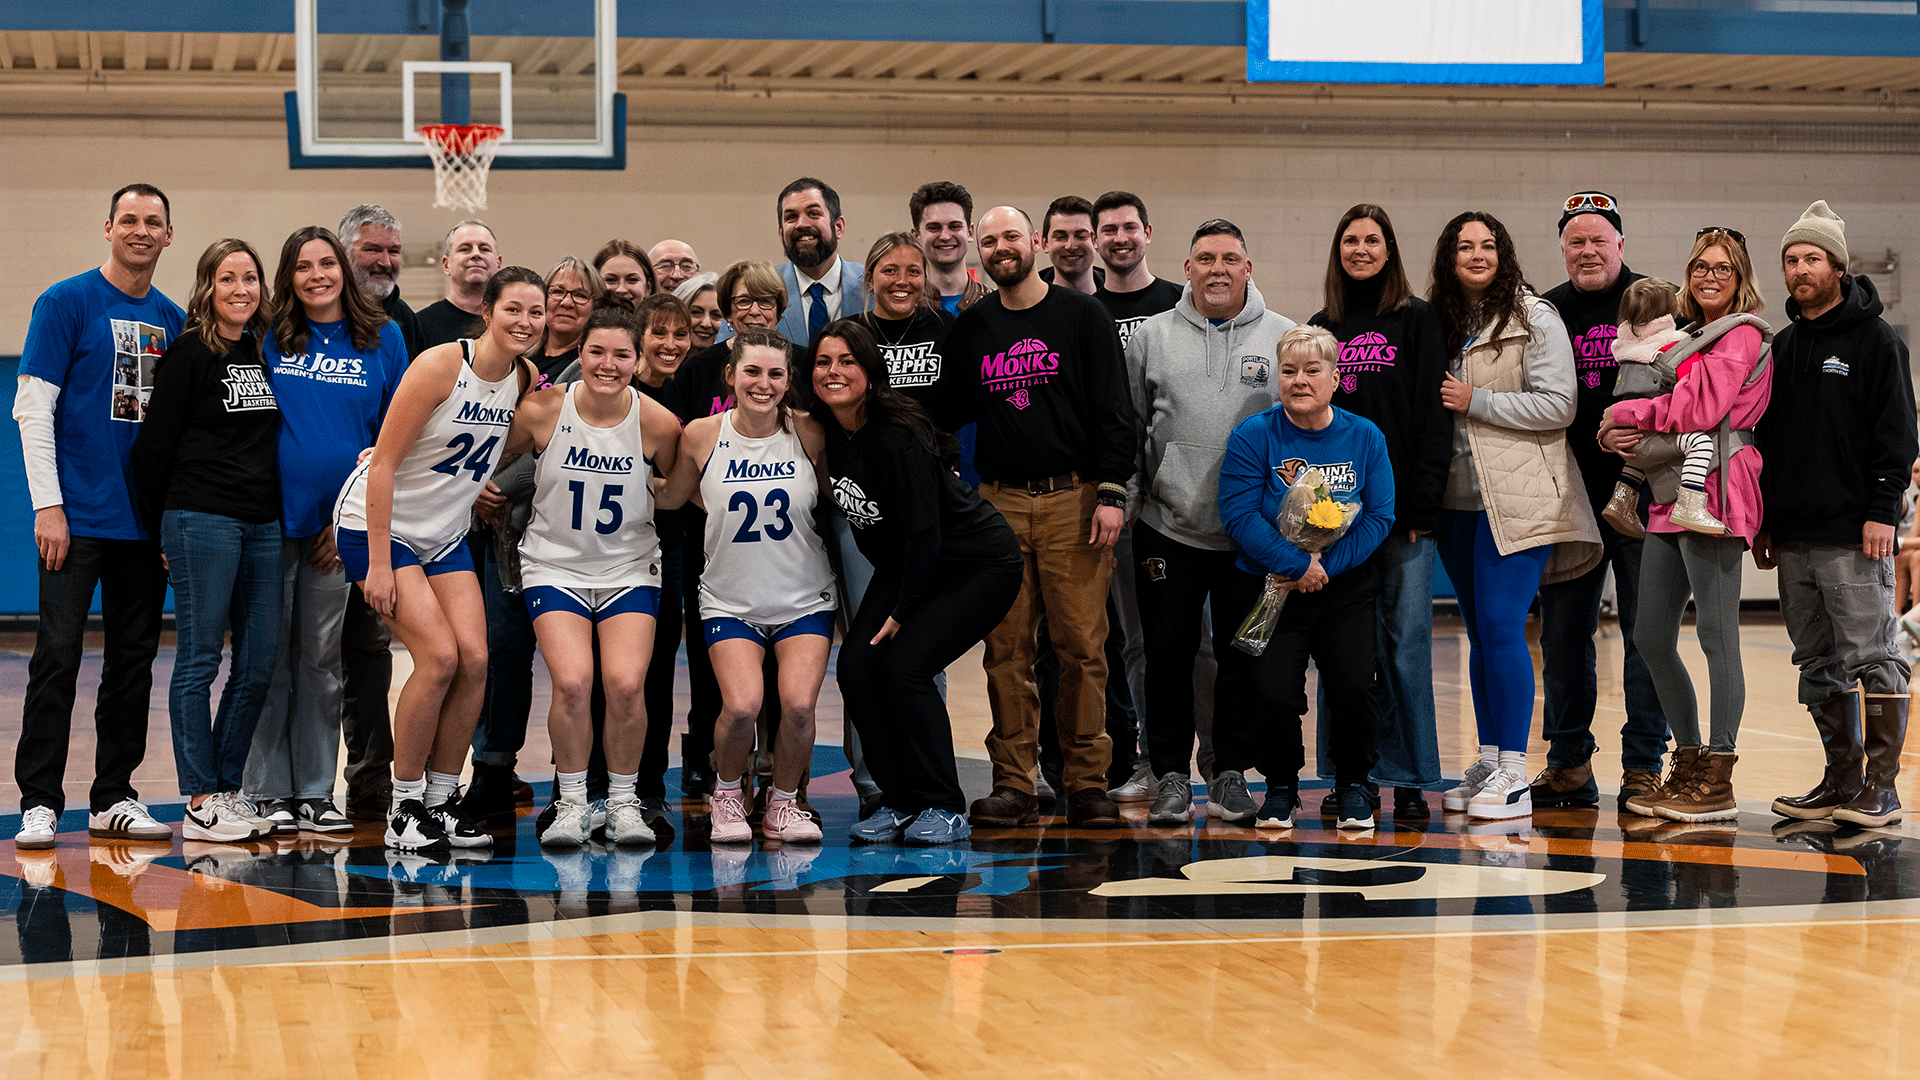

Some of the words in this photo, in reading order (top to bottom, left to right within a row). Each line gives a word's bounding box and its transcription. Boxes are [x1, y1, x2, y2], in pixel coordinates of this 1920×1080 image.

[305, 352, 363, 374] JOE'S
[881, 345, 929, 362] AINT
[273, 366, 314, 380] WOMEN'S
[315, 373, 368, 387] BASKETBALL
[886, 357, 938, 377] SEPH'S
[980, 352, 1060, 380] MONKS
[1338, 365, 1382, 374] KETBALL
[889, 375, 929, 386] KETBALL
[989, 376, 1049, 393] BASKETBALL
[230, 382, 274, 406] JOSEPH
[242, 398, 278, 408] BASKETBAL
[456, 400, 514, 424] MONKS
[429, 432, 501, 483] 24
[563, 445, 634, 471] MONKS
[725, 459, 796, 479] MONKS
[1324, 472, 1355, 484] EPH'S
[568, 479, 624, 535] 15
[831, 482, 880, 518] ONKS
[728, 488, 794, 543] 23
